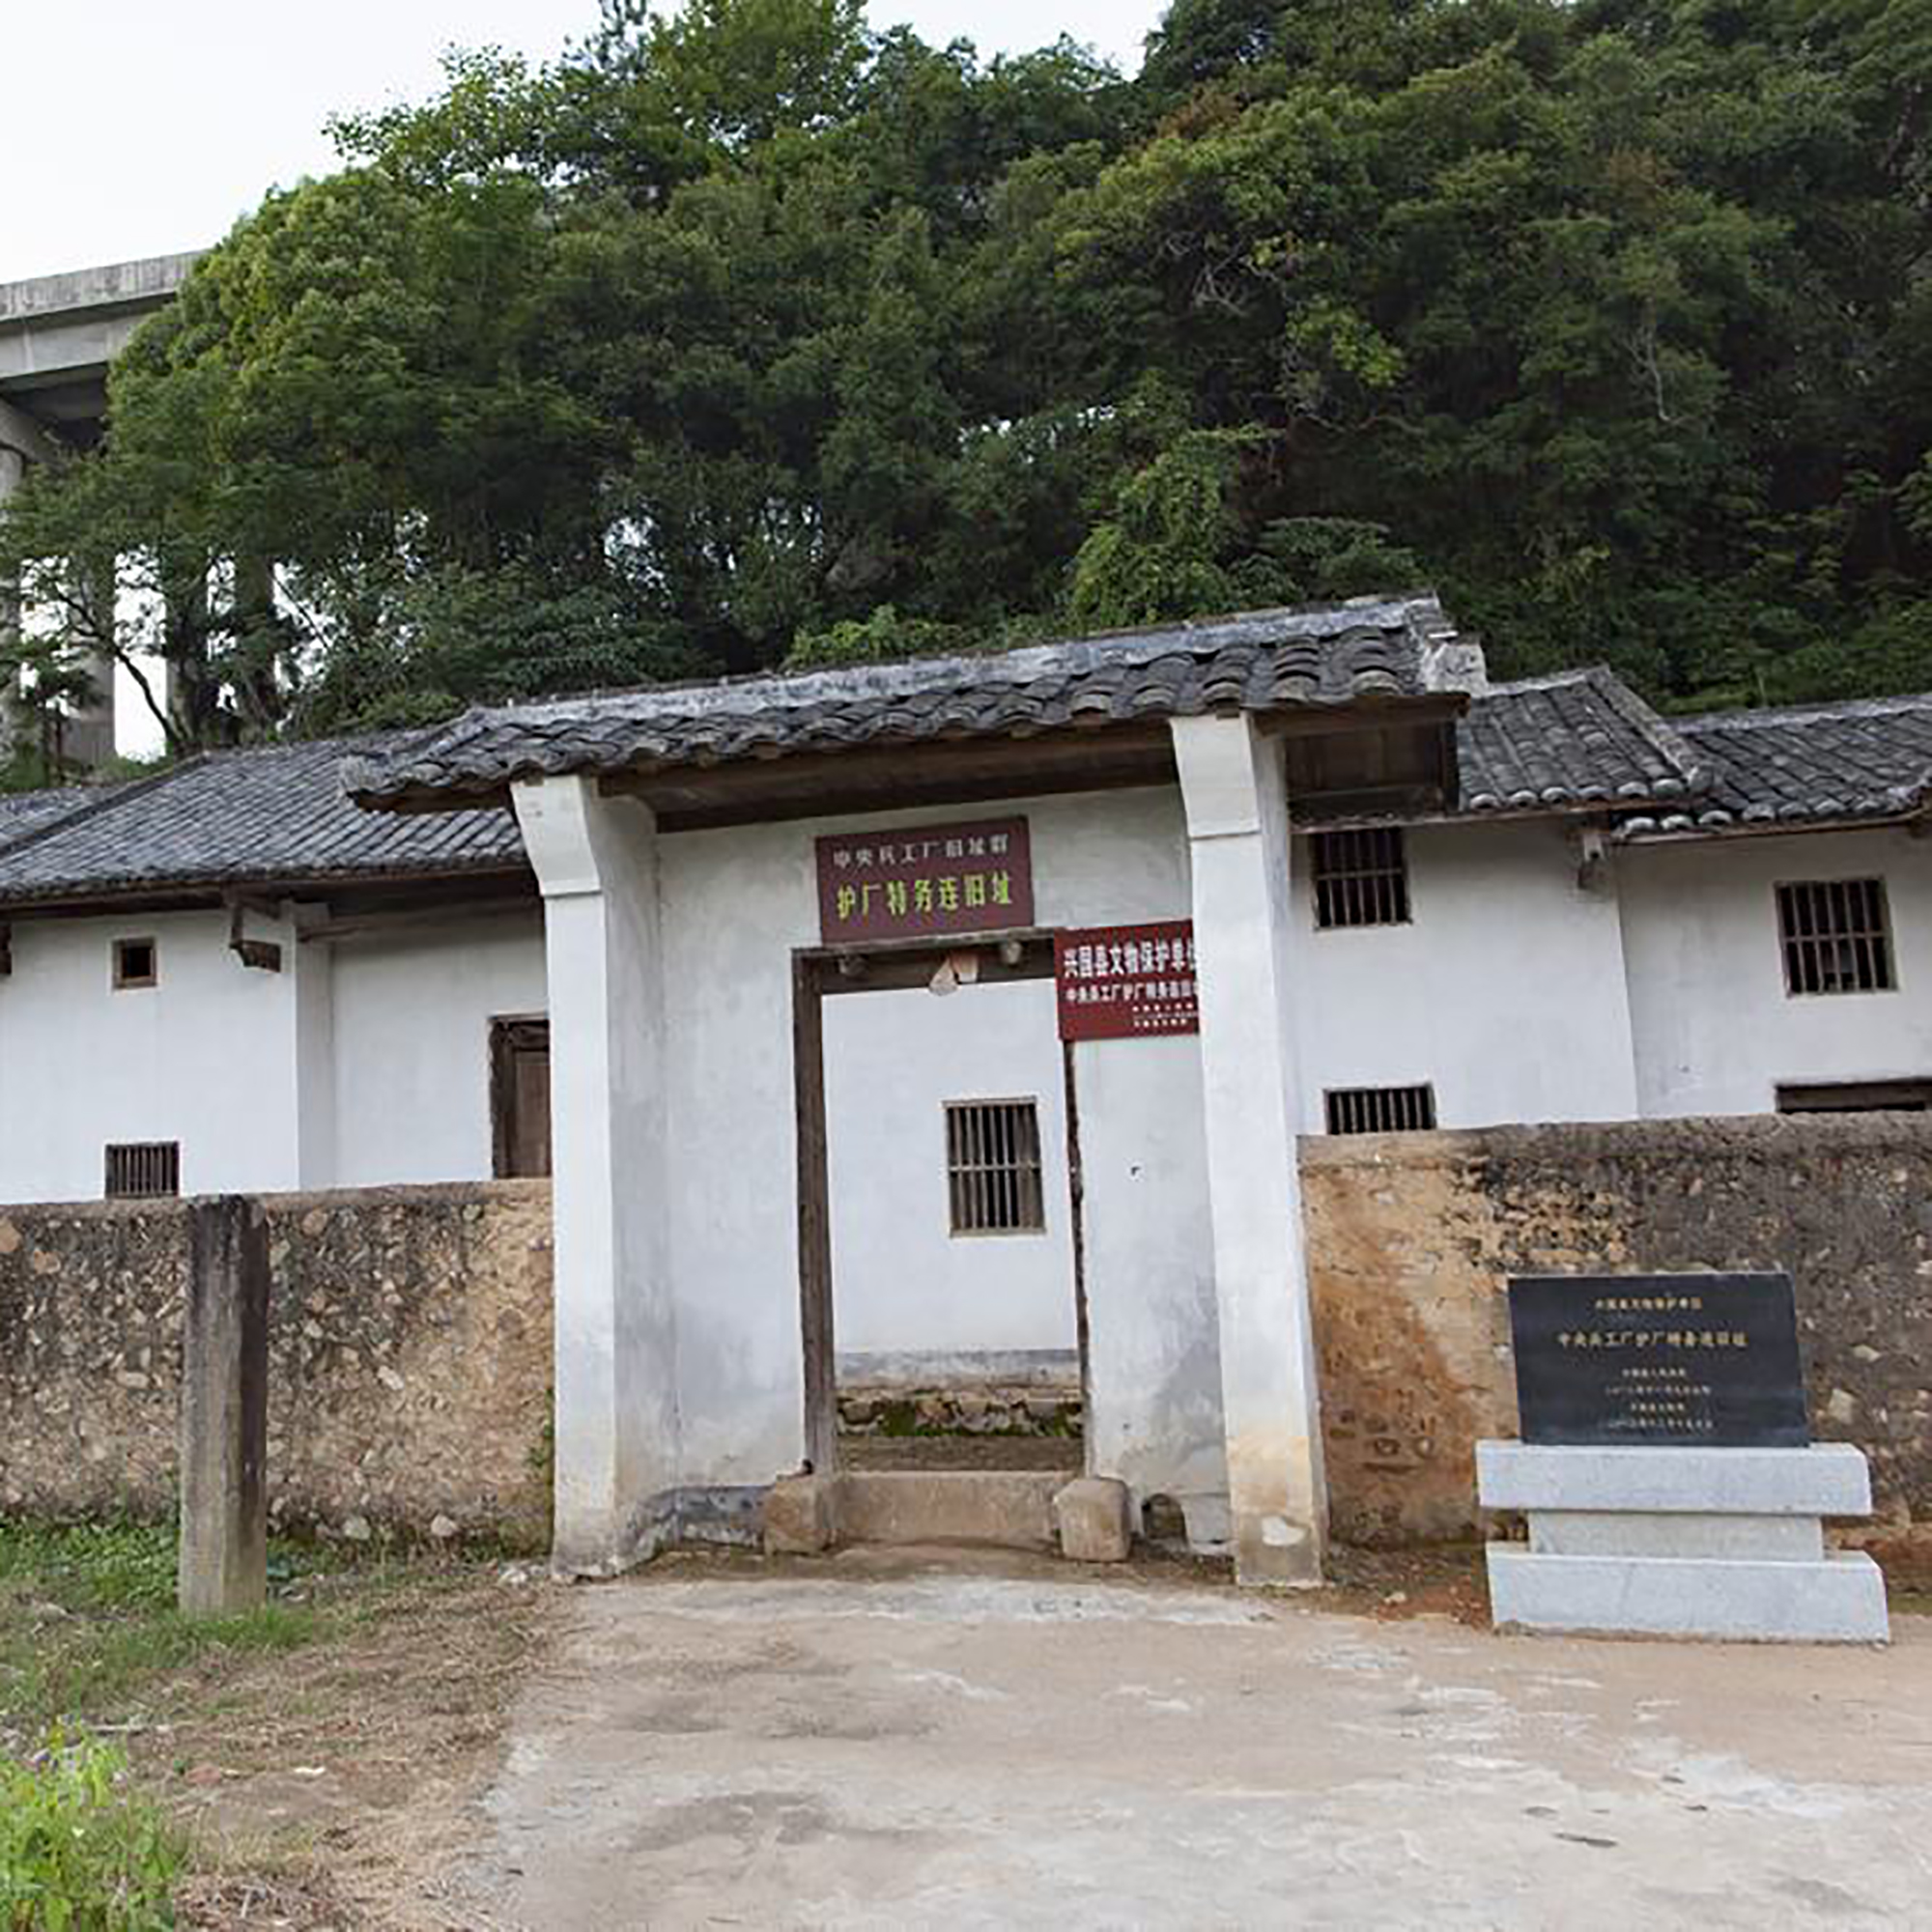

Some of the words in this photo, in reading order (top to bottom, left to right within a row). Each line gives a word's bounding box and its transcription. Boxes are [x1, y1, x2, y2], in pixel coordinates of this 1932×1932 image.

[837, 871, 1012, 919] 护厂特务连旧址
